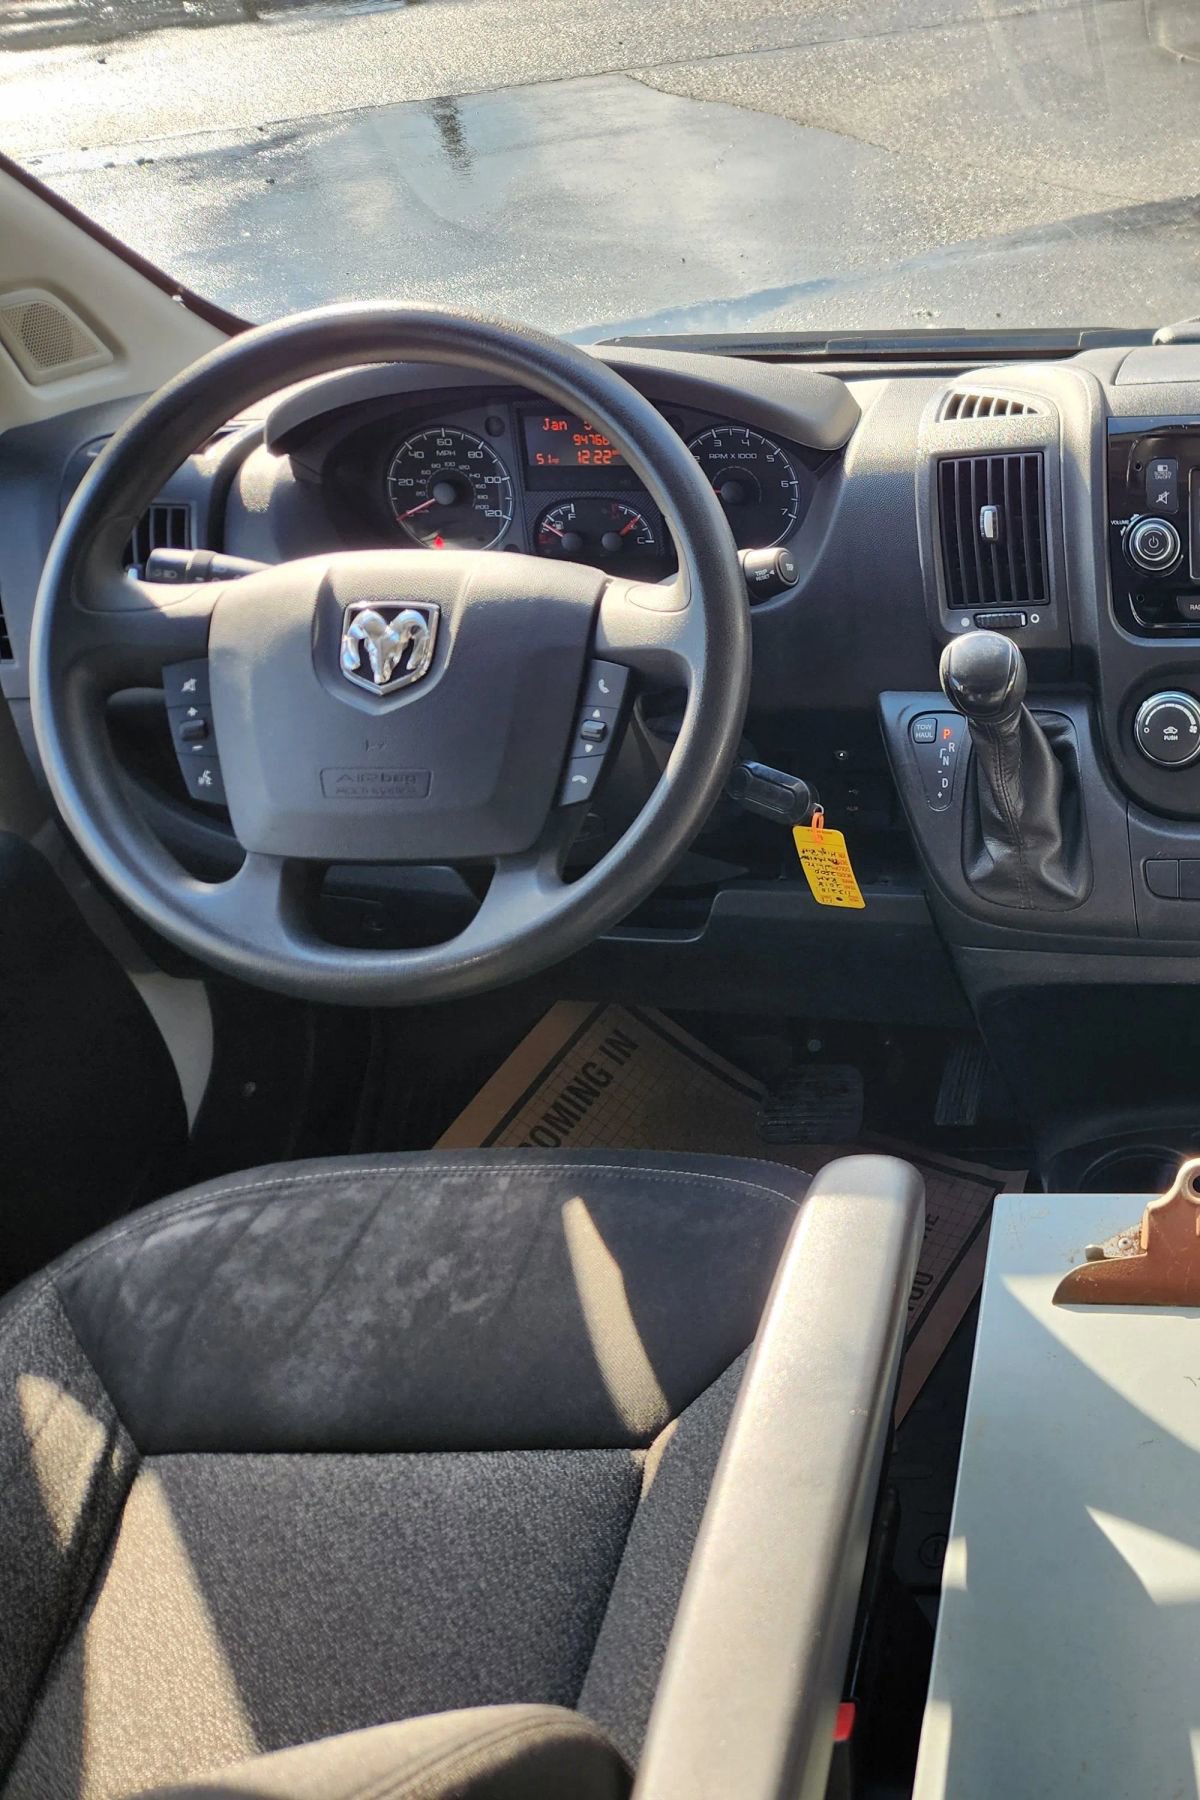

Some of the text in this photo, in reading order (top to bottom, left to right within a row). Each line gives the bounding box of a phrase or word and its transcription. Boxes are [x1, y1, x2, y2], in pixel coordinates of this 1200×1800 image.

[542, 418, 568, 431] Jan
[437, 438, 453, 446] 60
[713, 439, 722, 447] 3
[741, 439, 751, 447] 4
[408, 451, 424, 459] 40
[436, 449, 456, 457] MPH
[467, 451, 484, 459] 80
[738, 452, 758, 460] 1000
[766, 455, 775, 463] 5
[484, 476, 502, 484] 100
[780, 480, 789, 488] 6
[484, 509, 503, 517] 120
[943, 728, 951, 740] P
[948, 742, 956, 753] R
[942, 756, 950, 766] N
[941, 778, 949, 788] D
[518, 1028, 640, 1148] OMING IN
